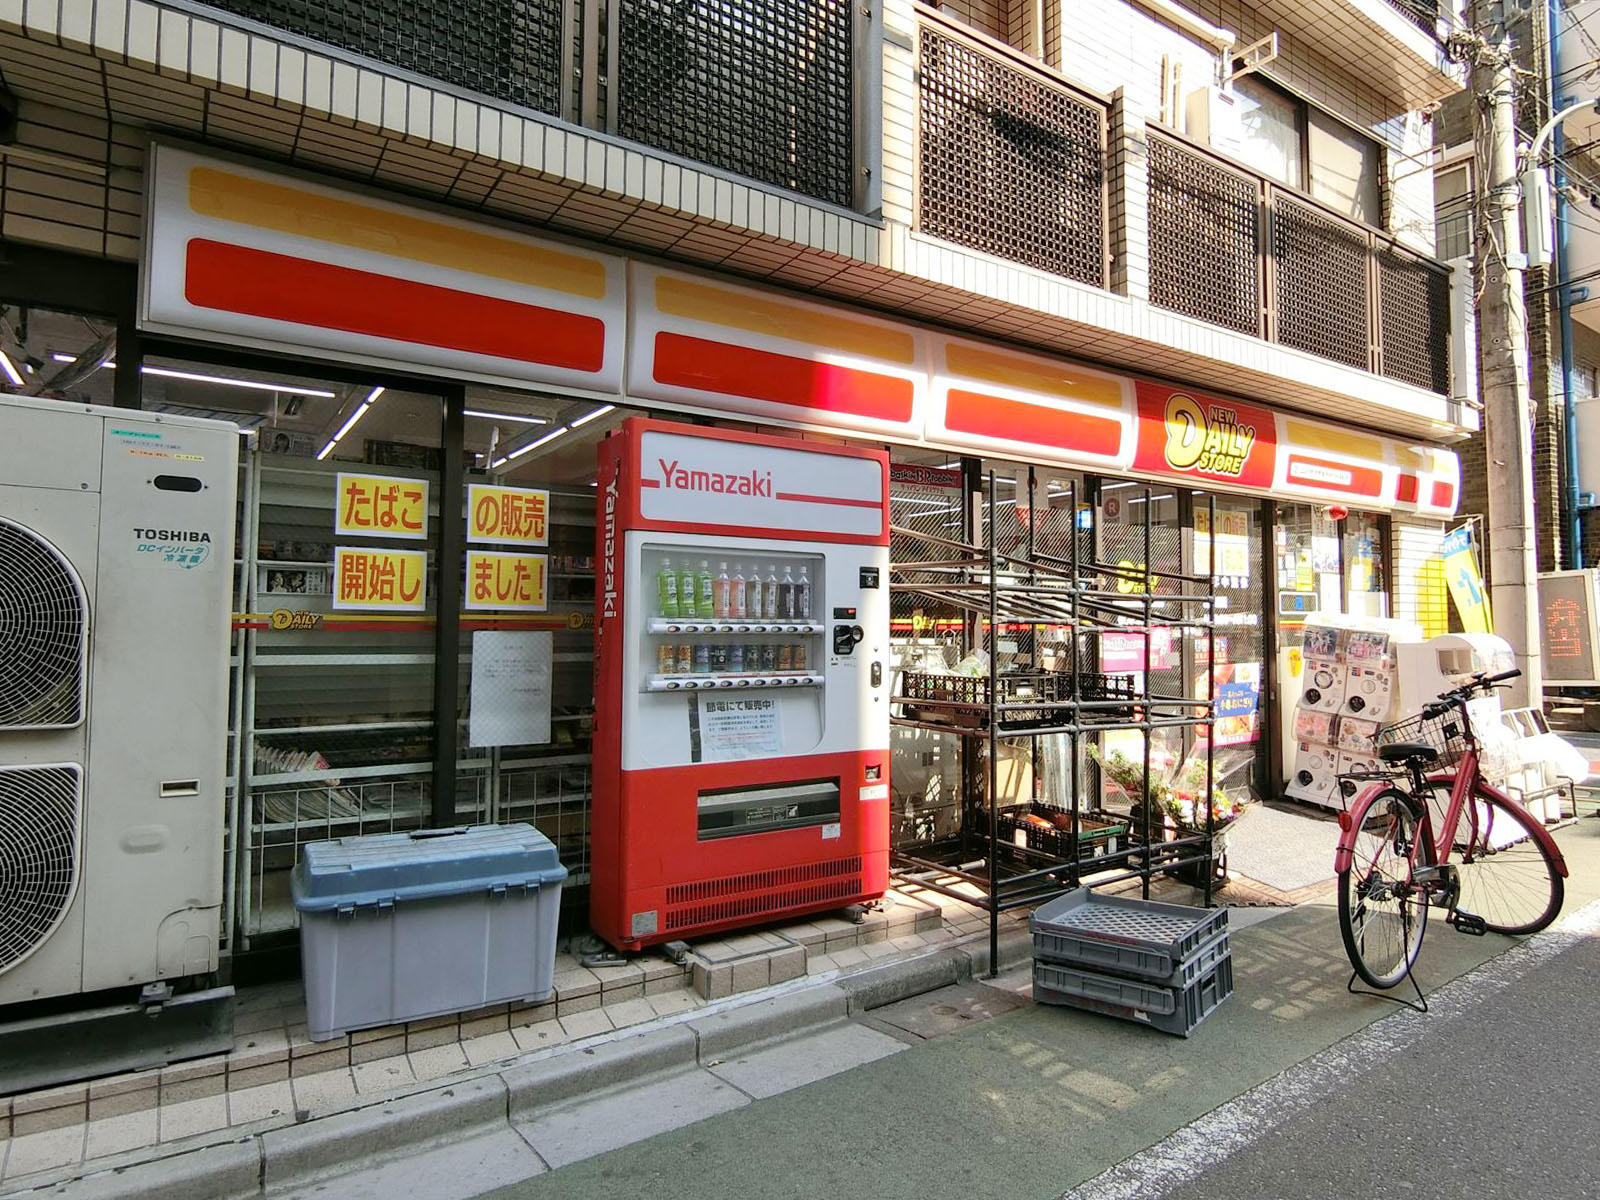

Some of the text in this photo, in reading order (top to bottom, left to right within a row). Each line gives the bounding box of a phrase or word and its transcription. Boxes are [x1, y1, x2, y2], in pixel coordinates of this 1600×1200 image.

[1165, 393, 1255, 468] DAILY
[1209, 407, 1236, 424] NEW
[659, 458, 772, 498] Yamazaki
[1199, 451, 1242, 475] STORE
[344, 482, 422, 530] たばこ
[476, 494, 545, 538] の販売
[133, 528, 211, 543] TOSHIBA
[603, 480, 619, 618] Yamazaki
[341, 554, 421, 601] 開始し
[474, 558, 544, 601] ました!
